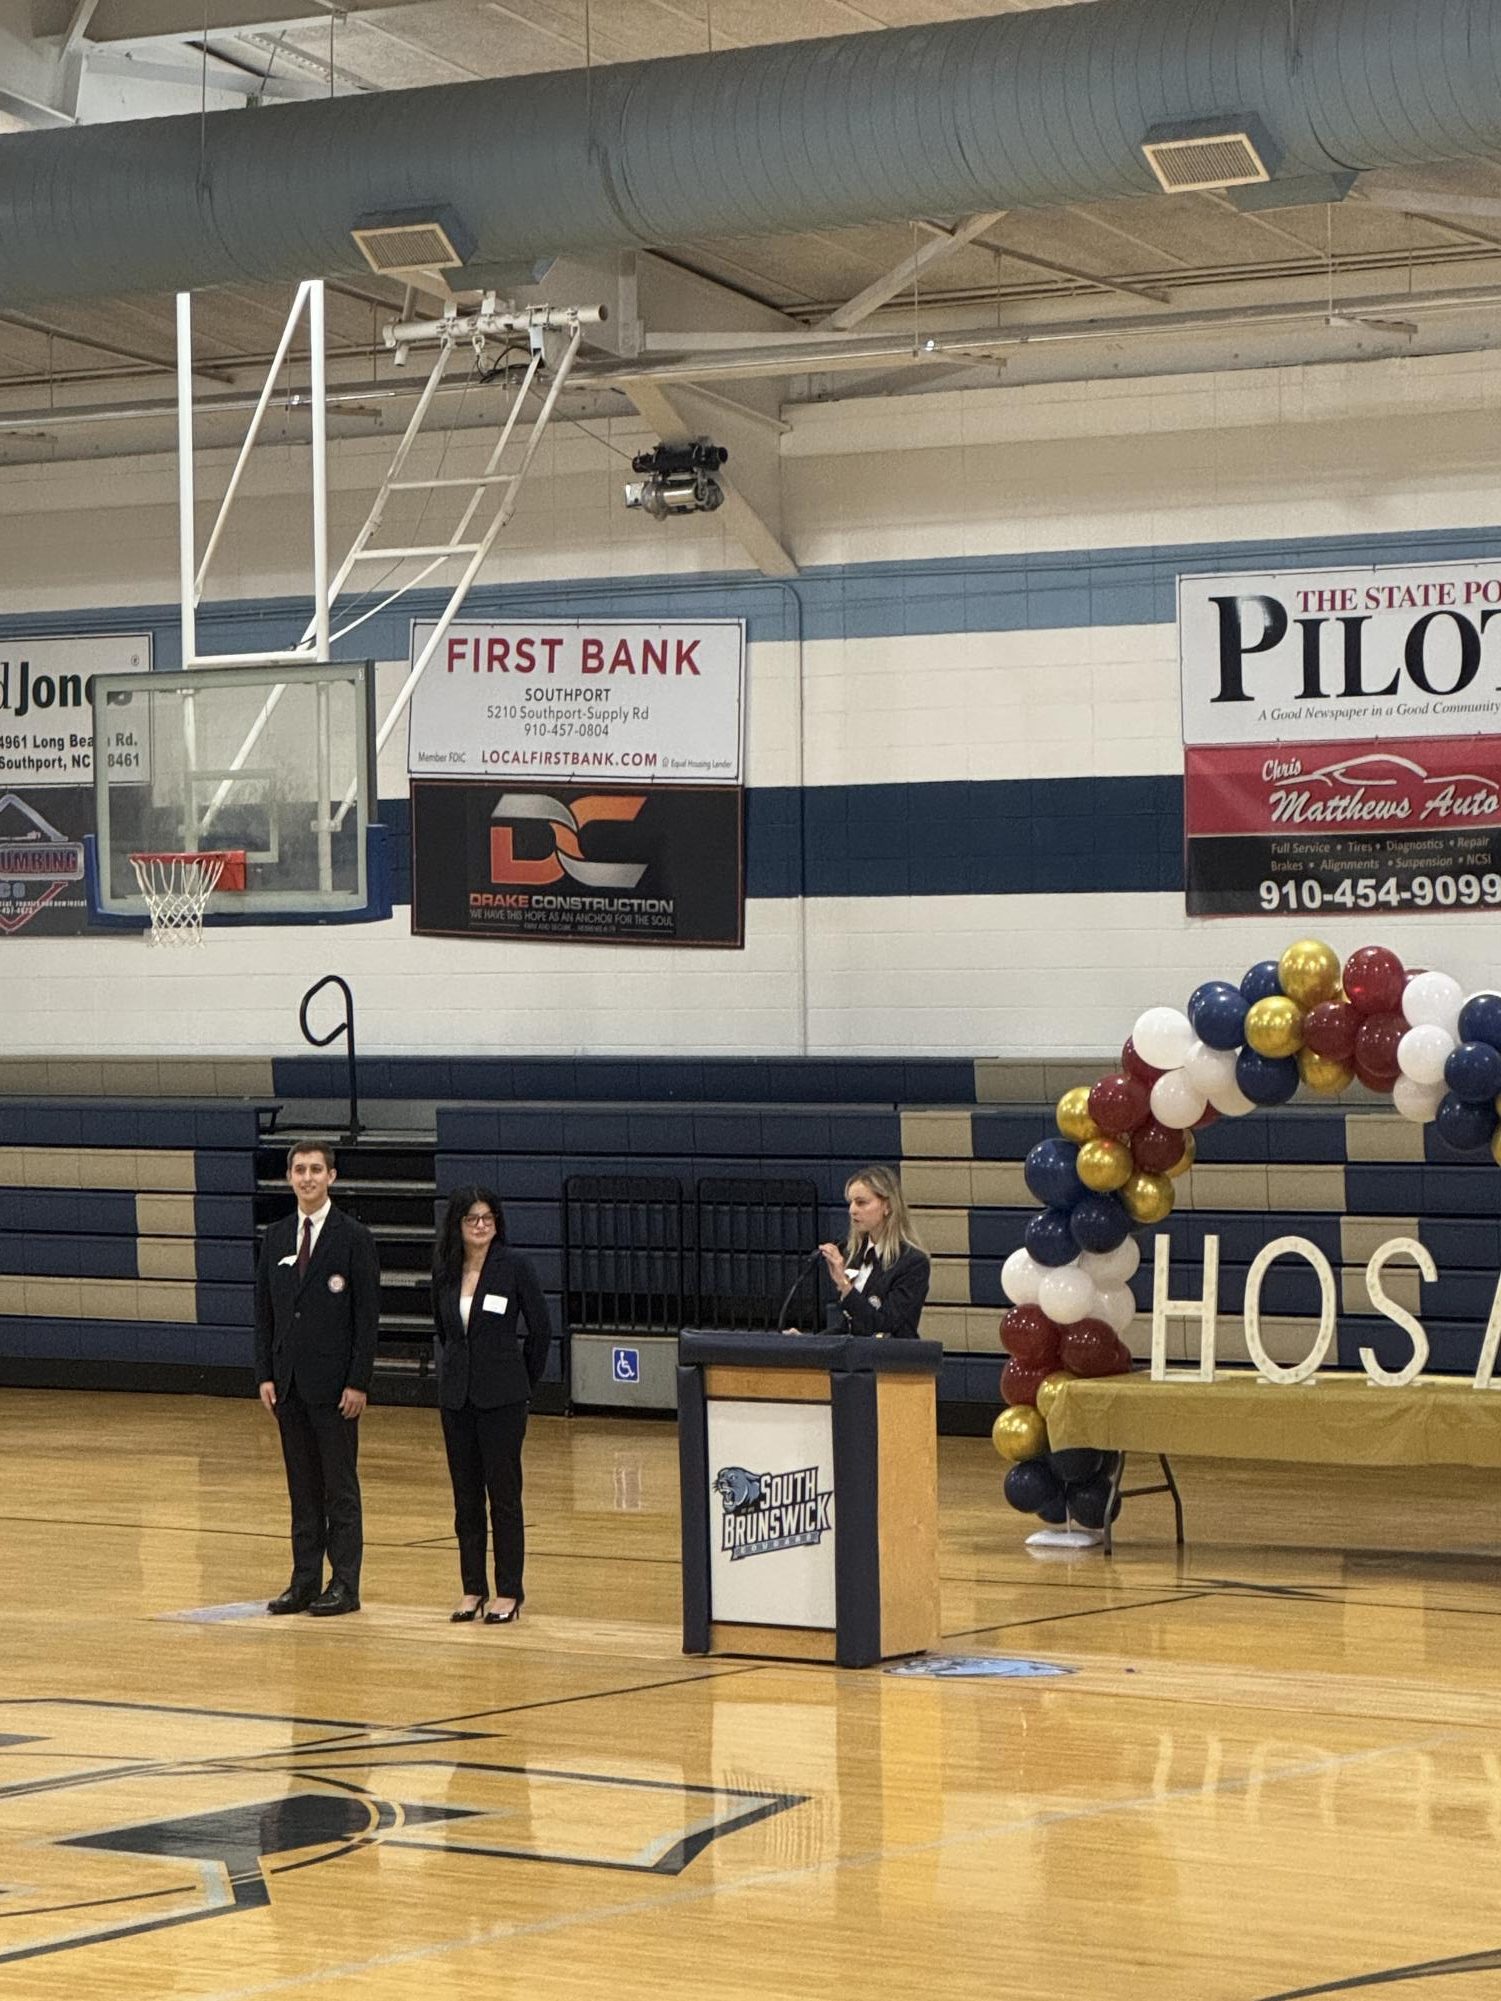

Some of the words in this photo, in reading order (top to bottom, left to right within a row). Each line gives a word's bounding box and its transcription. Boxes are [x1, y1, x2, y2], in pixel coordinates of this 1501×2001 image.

[1297, 588, 1358, 613] THE
[1365, 582, 1456, 610] STATE
[447, 638, 564, 673] FIRST
[581, 639, 701, 675] BANK
[525, 688, 611, 702] SOUTHPORT
[487, 705, 517, 719] 5210
[520, 706, 629, 724] Southport-Supply
[632, 706, 649, 720] Rd
[1258, 709, 1267, 720] A
[1271, 707, 1301, 720] Good
[1305, 705, 1368, 720] Newspaper
[1371, 704, 1382, 716] in
[1386, 707, 1393, 716] a
[1397, 702, 1430, 715] Good
[1433, 700, 1501, 715] Community
[524, 723, 609, 736] 910-457-0804
[33, 735, 65, 751] Long
[70, 734, 110, 749] Bea
[116, 732, 138, 747] Rd.
[72, 754, 91, 768] NC
[106, 753, 140, 768] 8461
[418, 752, 447, 762] Member
[449, 752, 466, 763] FDIC
[482, 750, 657, 766] LOCALFIRSTBANK.COM
[1262, 757, 1301, 782] Chris
[1269, 787, 1412, 823] Matthews
[1420, 784, 1499, 820] Auto
[1271, 843, 1290, 854] Full
[1292, 842, 1330, 854] Service
[1347, 841, 1373, 852] Tires
[1386, 839, 1444, 853] Diagnostics
[1457, 836, 1490, 849] Repair
[1271, 861, 1303, 872] Brakes
[1320, 859, 1379, 872] Alignments
[1396, 857, 1453, 869] Suspension
[1259, 873, 1501, 910] 910-454-9099
[470, 893, 529, 908] DRAKE
[532, 896, 674, 913] CONSTRUCTION
[524, 911, 546, 922] HOPE
[760, 1469, 816, 1510] SOUTH
[723, 1494, 830, 1549] BRUNSWICK
